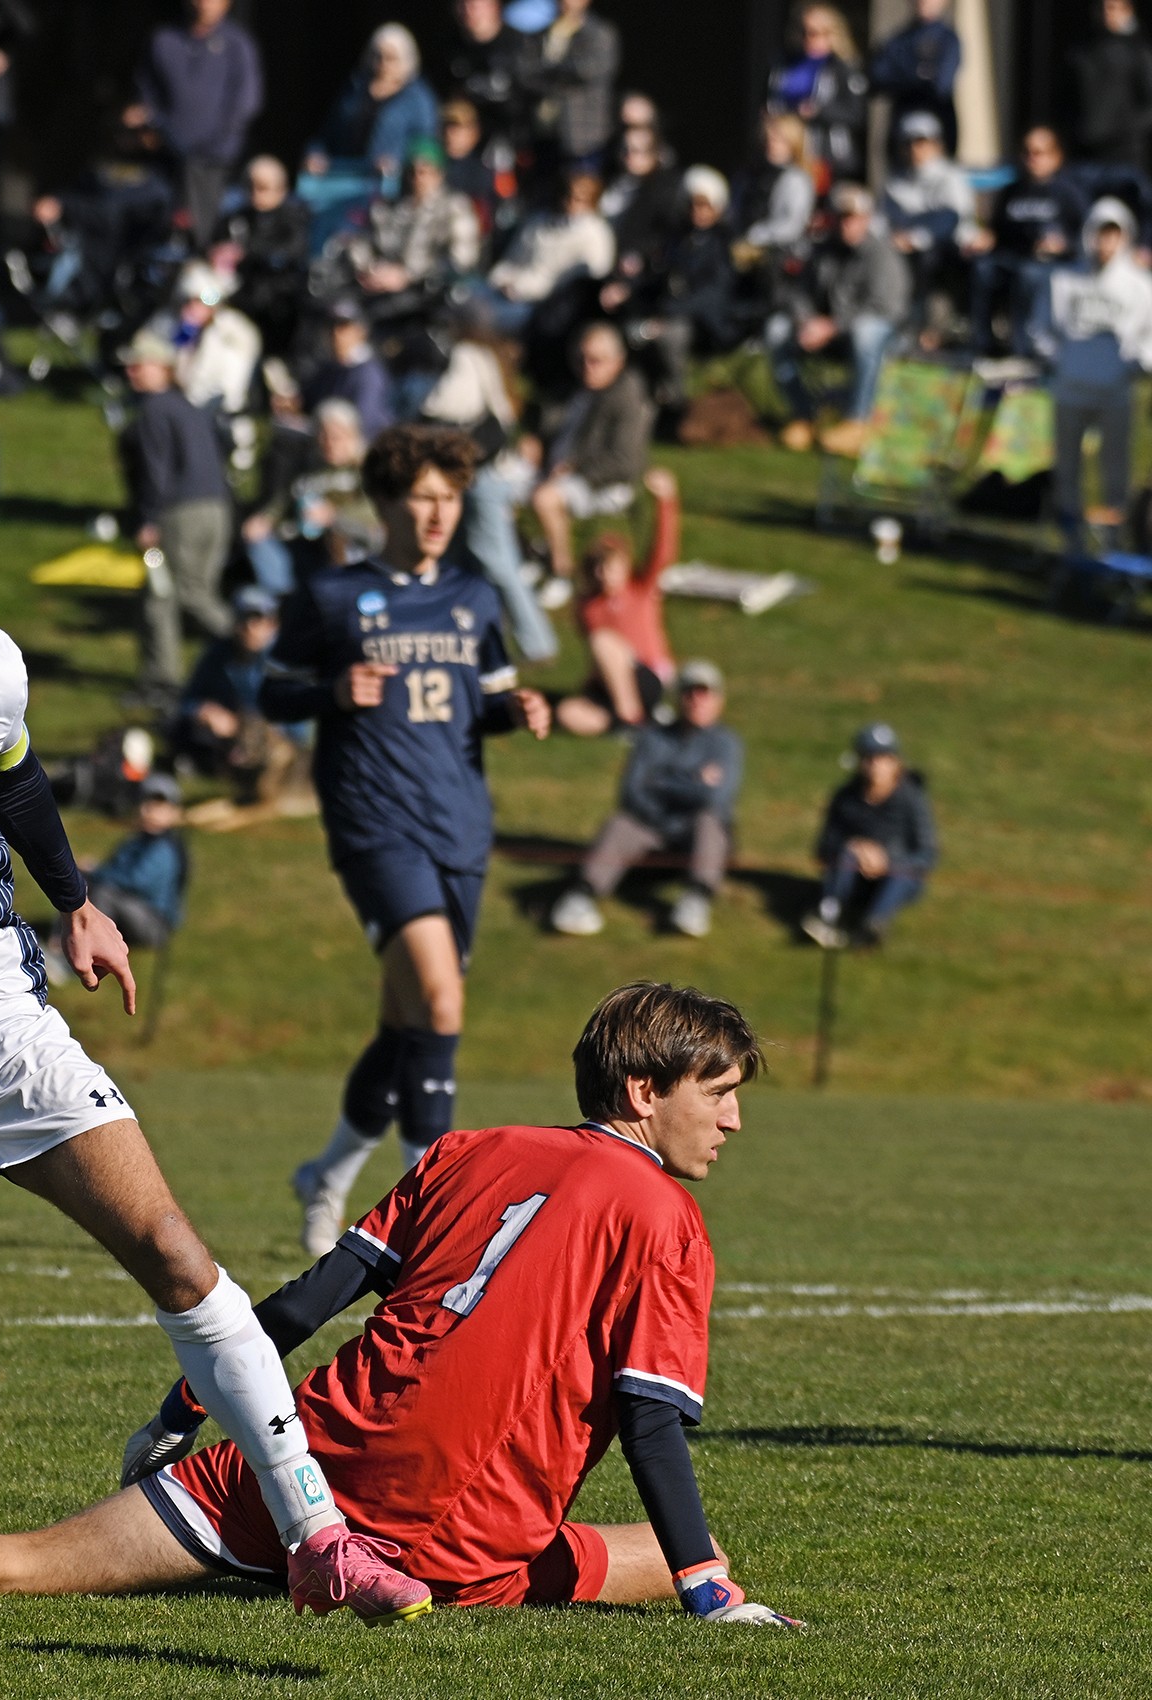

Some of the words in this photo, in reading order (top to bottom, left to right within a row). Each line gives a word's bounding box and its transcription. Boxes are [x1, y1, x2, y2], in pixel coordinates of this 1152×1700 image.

[361, 633, 478, 666] SUFFOLK
[406, 669, 451, 723] 12
[440, 1192, 549, 1318] 1
